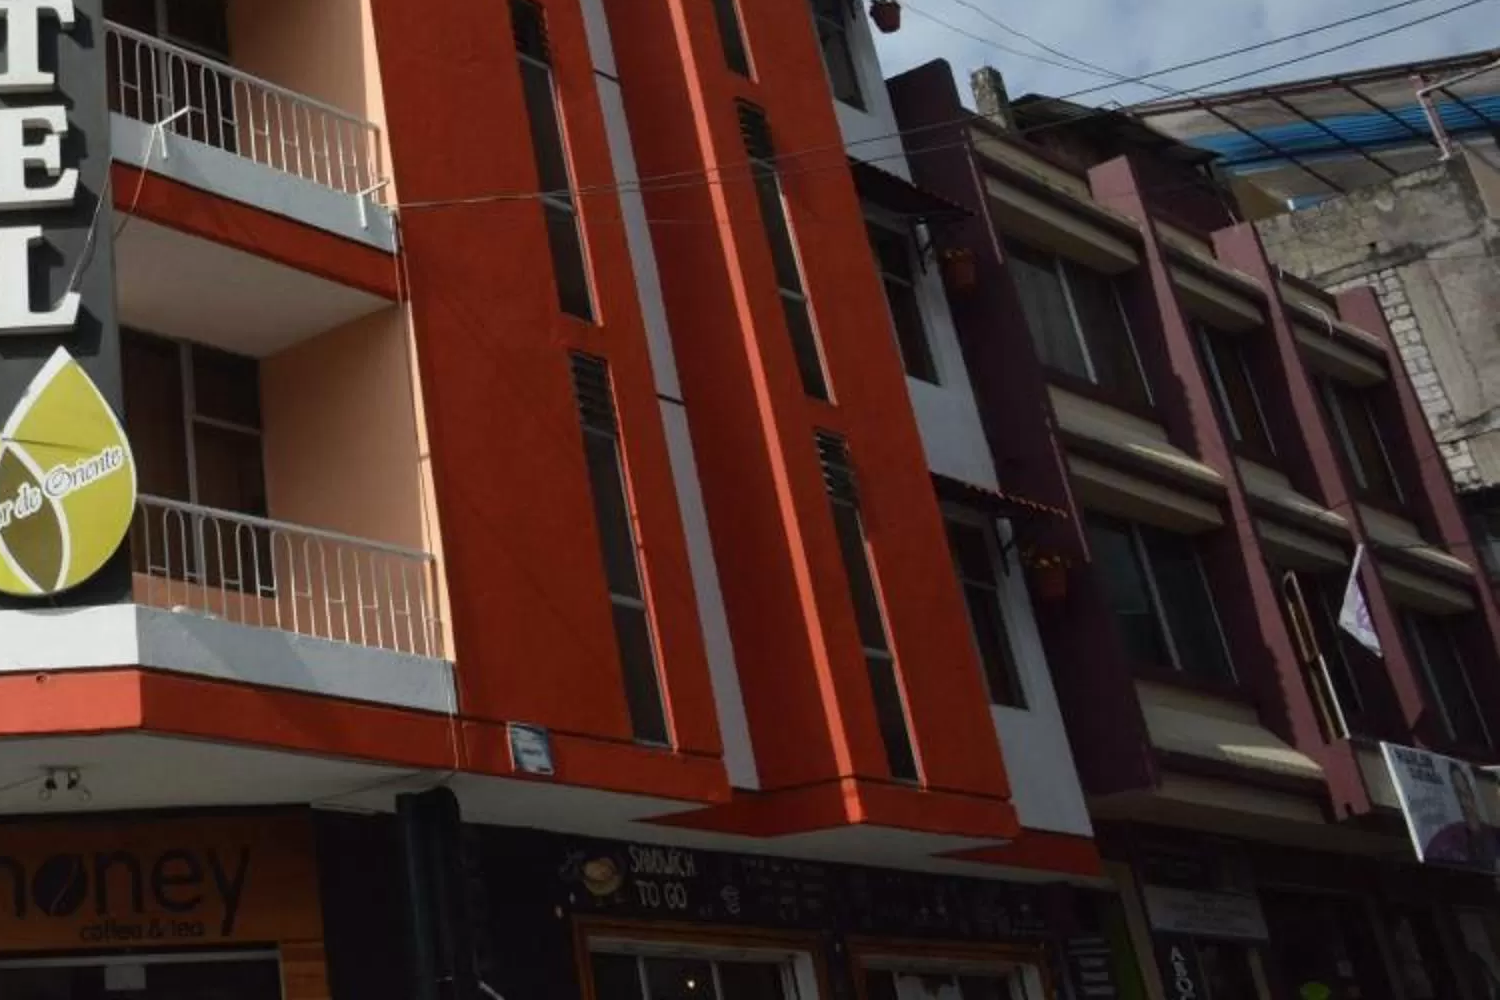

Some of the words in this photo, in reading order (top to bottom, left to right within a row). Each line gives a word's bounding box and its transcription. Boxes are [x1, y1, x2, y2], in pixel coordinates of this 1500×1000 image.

[16, 484, 41, 517] de
[44, 447, 122, 498] Oriente
[634, 879, 660, 909] TO
[663, 882, 688, 910] GO
